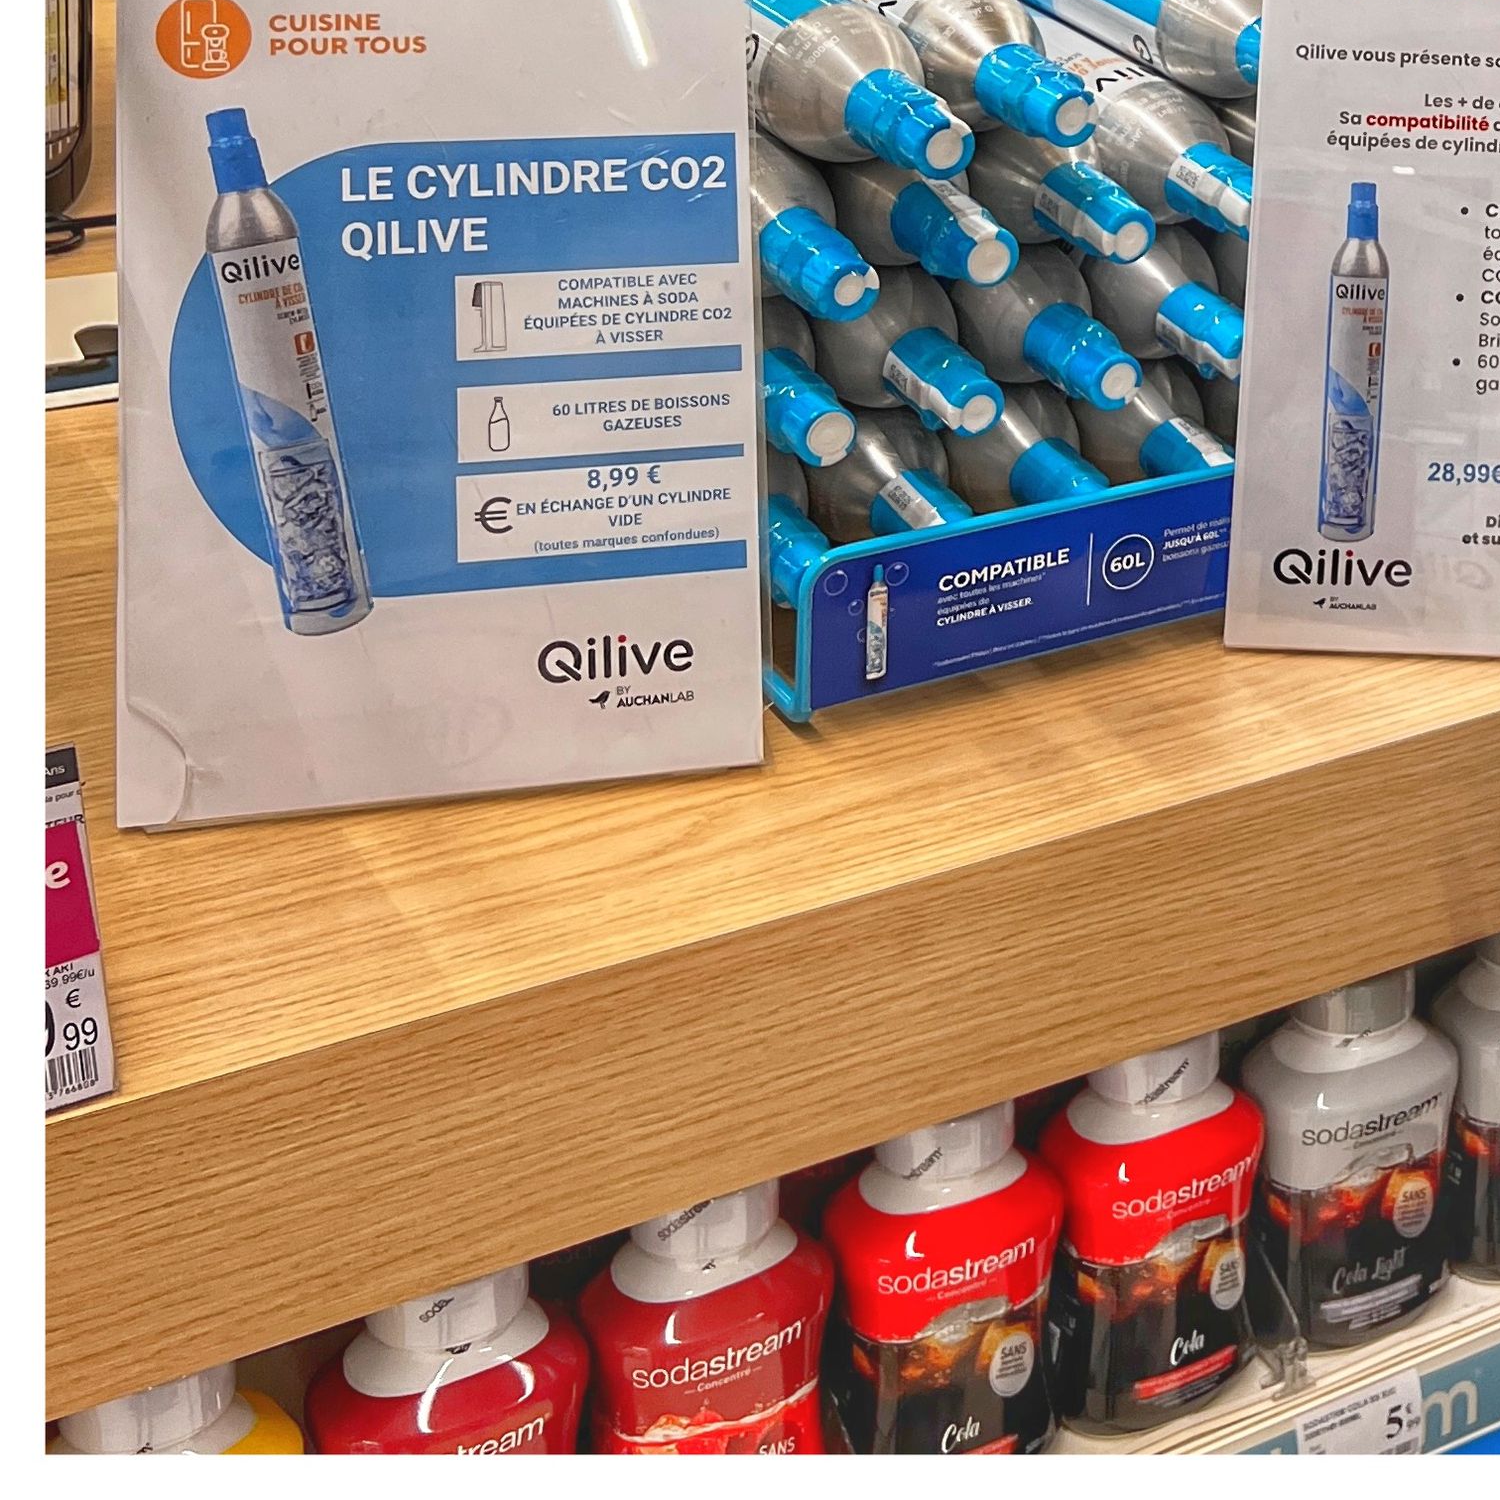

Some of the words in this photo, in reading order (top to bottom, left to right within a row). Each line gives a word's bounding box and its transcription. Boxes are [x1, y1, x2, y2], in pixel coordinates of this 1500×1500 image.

[269, 13, 381, 33] CUISINE
[269, 36, 348, 56] POUR
[356, 35, 427, 54] TOUS
[1296, 43, 1347, 62] Qilive
[1352, 49, 1396, 64] vous
[1400, 48, 1481, 71] présente
[1424, 93, 1453, 109] Les
[1339, 111, 1362, 126] Sa
[1366, 111, 1489, 135] compatibilité
[1326, 131, 1411, 154] équipées
[342, 167, 393, 202] LE
[407, 159, 628, 199] CYLINDRE
[640, 156, 727, 190] CO2
[342, 217, 489, 258] QILIVE
[221, 253, 300, 283] Qilive
[558, 276, 653, 291] COMPATIBLE
[658, 274, 698, 287] AVEC
[1336, 284, 1385, 300] Qilive
[558, 294, 638, 310] MACHINES
[657, 291, 699, 304] SODA
[523, 312, 597, 331] ÉQUIPÉES
[624, 309, 698, 325] CYLINDRE
[703, 308, 732, 321] CO2
[610, 329, 663, 343] VISSER
[1478, 355, 1500, 370] 60
[552, 403, 570, 416] 60
[574, 400, 626, 415] LITRES
[654, 395, 730, 411] BOISSONS
[602, 415, 681, 432] GAZEUSES
[587, 466, 639, 491] 8,99
[647, 465, 661, 484] €
[541, 494, 613, 514] ÉCHANGE
[657, 487, 731, 507] CYLINDRE
[608, 513, 642, 527] VIDE
[534, 538, 577, 553] (toutes
[581, 535, 637, 550] marques
[642, 526, 720, 545] confondues)
[938, 547, 1070, 592] COMPATIBLE
[1110, 553, 1145, 573] 60L
[1273, 548, 1412, 587] Qilive
[960, 586, 986, 600] toutes
[937, 607, 987, 627] CYLINDRE
[538, 635, 693, 683] Qilive
[616, 691, 694, 708] AUCHANLAB
[66, 988, 81, 1008] €
[63, 1017, 98, 1051] 99
[1302, 1094, 1439, 1147] sodastream
[1112, 1156, 1256, 1219] sodastream
[1402, 1187, 1427, 1203] SANS
[877, 1237, 1035, 1295] sodastream
[1332, 1262, 1368, 1295] Cola
[632, 1319, 801, 1389] sodastream
[1001, 1343, 1027, 1359] SANS
[1169, 1331, 1205, 1367] Cola
[1385, 1404, 1404, 1439] 5
[942, 1417, 981, 1454] Cola
